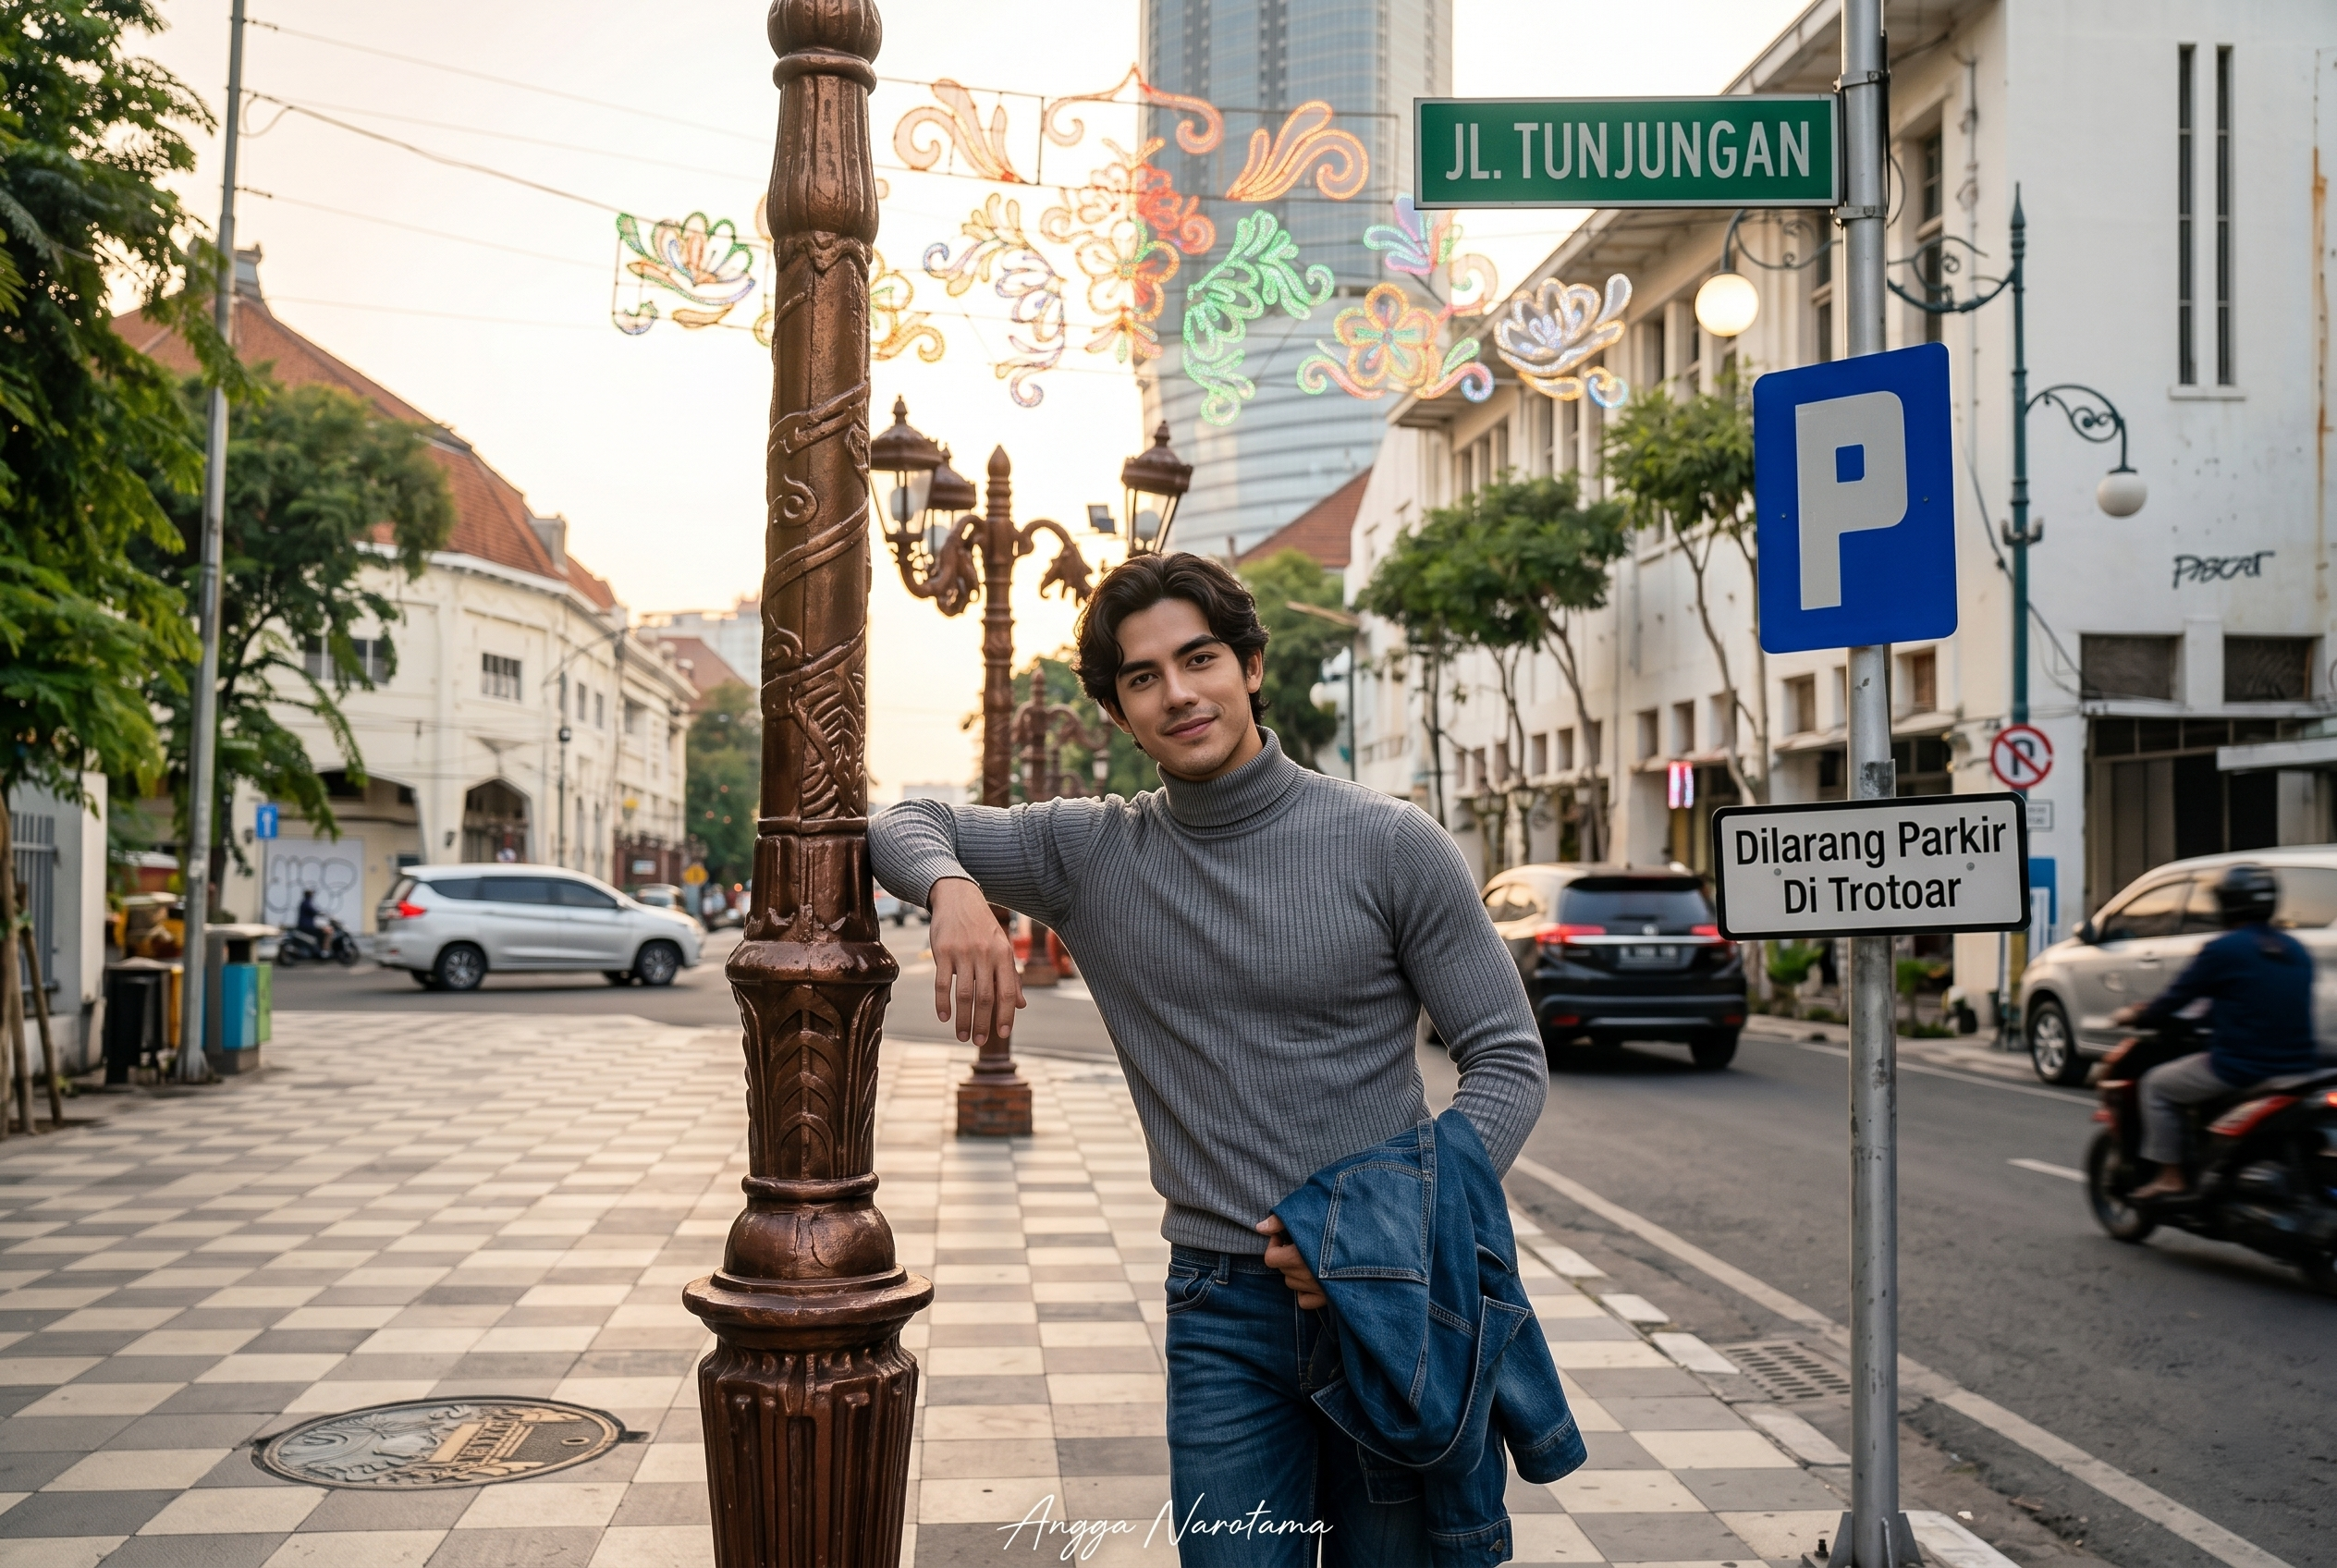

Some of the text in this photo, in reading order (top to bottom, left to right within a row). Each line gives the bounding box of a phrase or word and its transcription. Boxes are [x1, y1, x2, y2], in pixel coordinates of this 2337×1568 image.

[1445, 120, 1809, 180] JL. TUNJUNGAN
[1794, 390, 1908, 611] P
[1735, 827, 1886, 869] Dilarang
[1898, 815, 2007, 858] Parkir
[1783, 874, 1962, 914] Di Trotoar
